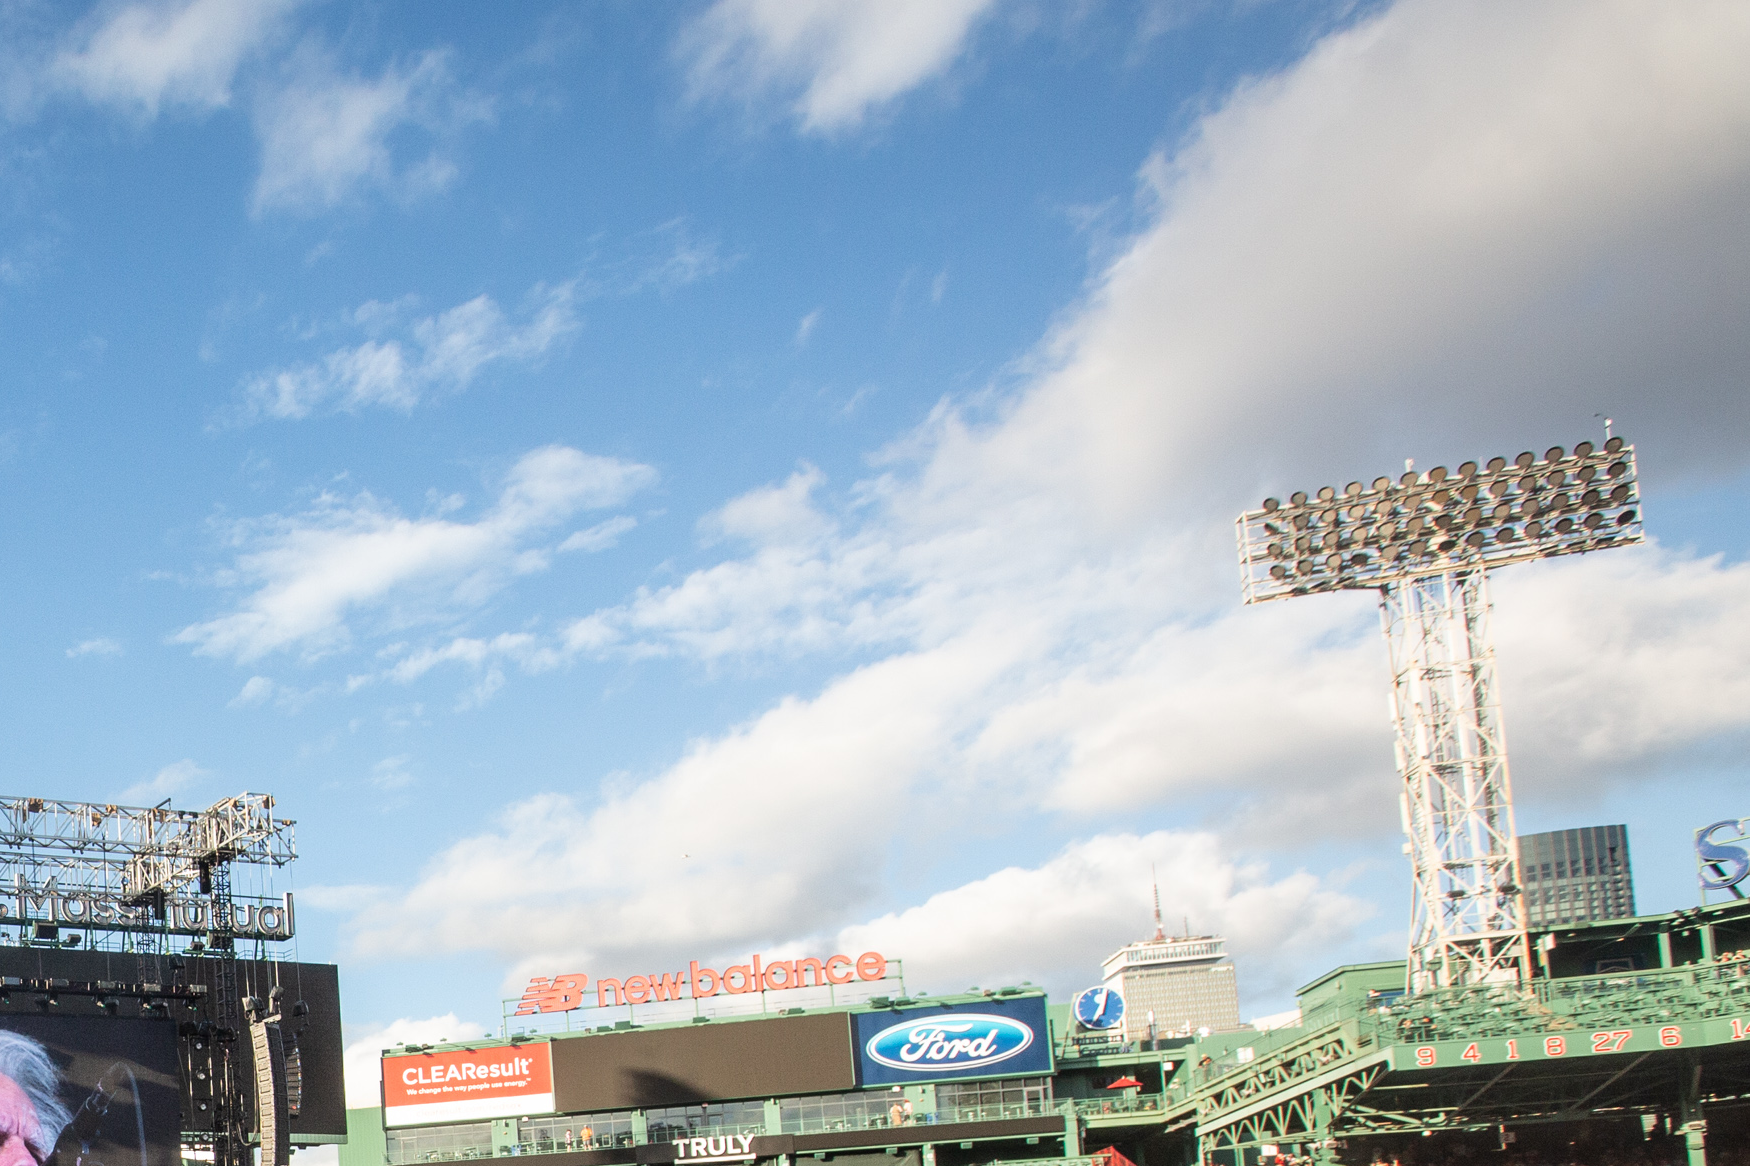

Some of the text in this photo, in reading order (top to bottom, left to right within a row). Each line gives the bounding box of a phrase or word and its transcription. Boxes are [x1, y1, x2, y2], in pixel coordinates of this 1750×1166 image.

[14, 873, 296, 936] Massuual
[900, 1023, 999, 1062] Ford
[1544, 1036, 1567, 1057] 8
[1591, 1029, 1632, 1053] 27
[1658, 1025, 1683, 1047] 6
[1416, 1046, 1436, 1067] 9
[1462, 1042, 1482, 1062] 4
[1506, 1039, 1520, 1060] 1
[402, 1057, 530, 1085] CLEAResult
[406, 1088, 417, 1096] We
[418, 1087, 442, 1095] change
[442, 1085, 453, 1093] the
[454, 1085, 467, 1093] way
[467, 1082, 490, 1091] people
[672, 1134, 755, 1157] TRULY
